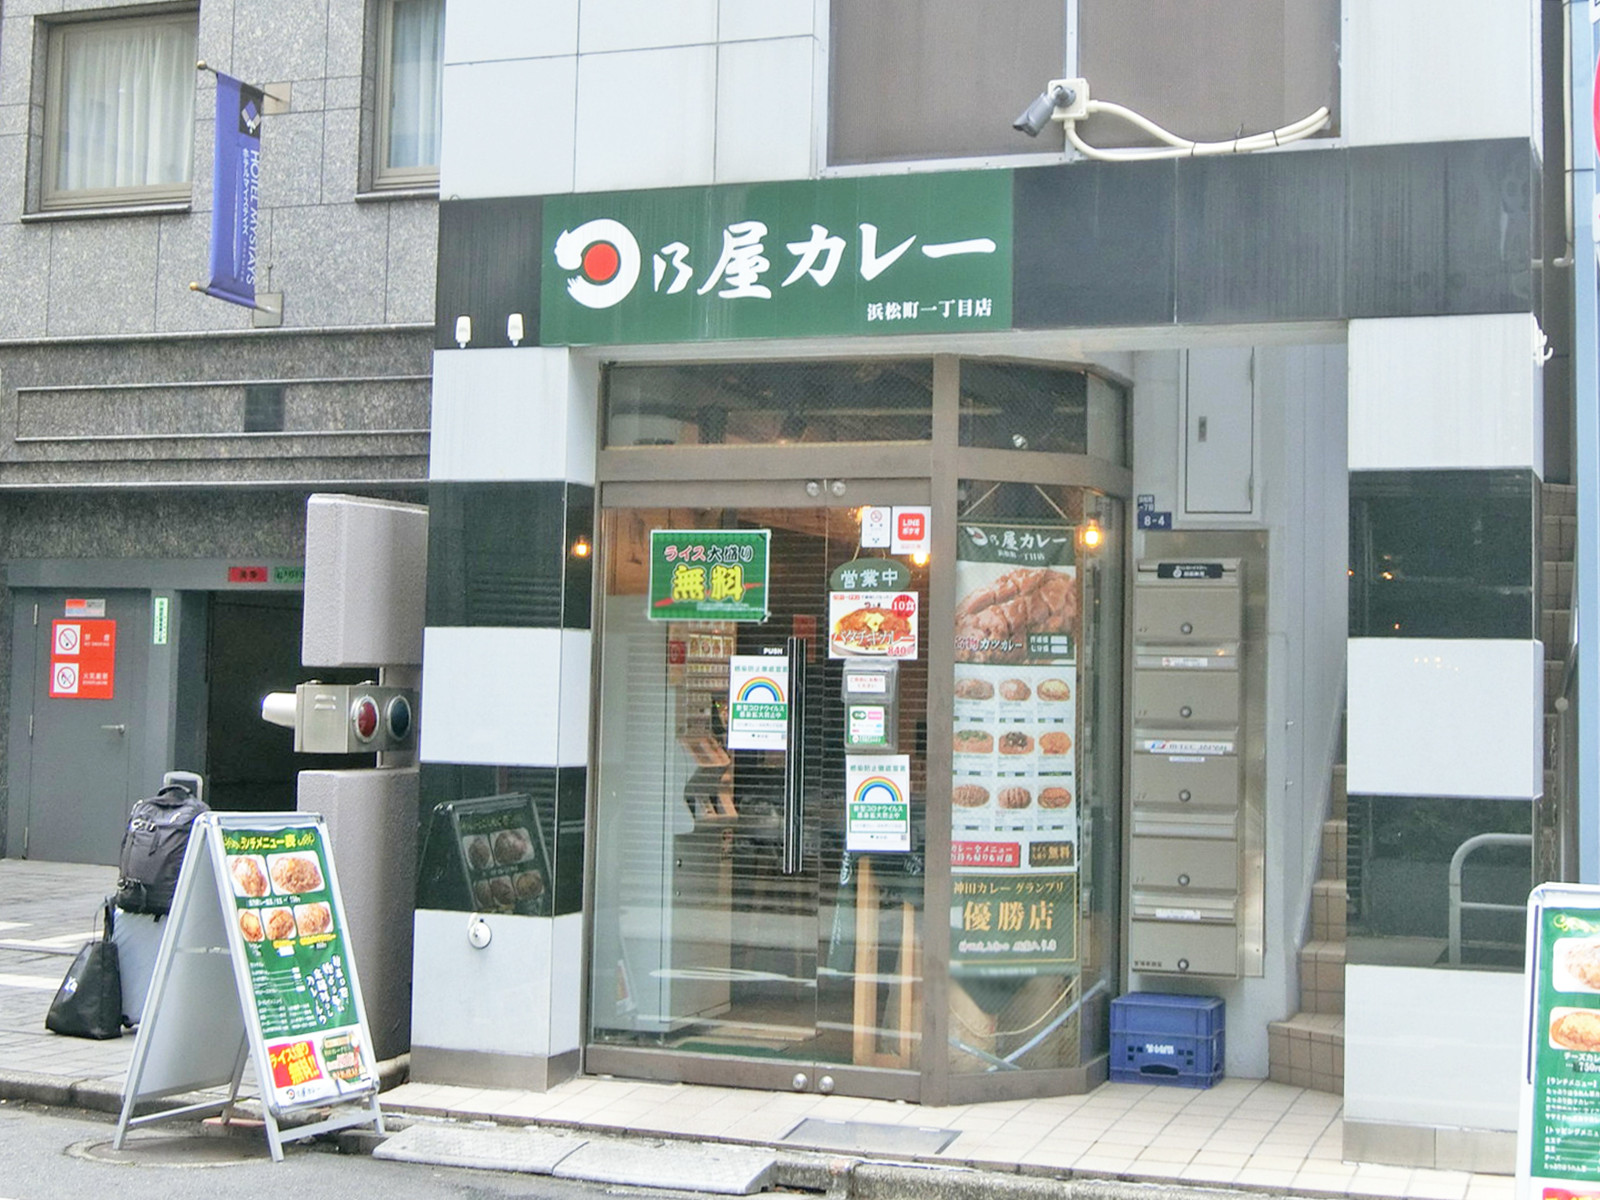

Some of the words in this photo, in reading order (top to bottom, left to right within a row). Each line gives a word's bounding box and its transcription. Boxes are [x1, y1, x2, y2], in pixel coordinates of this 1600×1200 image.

[250, 150, 260, 202] HOTEL
[246, 207, 258, 285] MYSTAYS
[867, 298, 992, 321] 浜松町一丁目店
[903, 518, 920, 526] LINE
[1144, 515, 1165, 526] 8-4
[664, 545, 754, 562] ライス大盛り
[671, 563, 746, 602] 無料
[840, 569, 898, 589] 営業中
[763, 647, 783, 655] PUSH
[964, 900, 1054, 932] 優勝店
